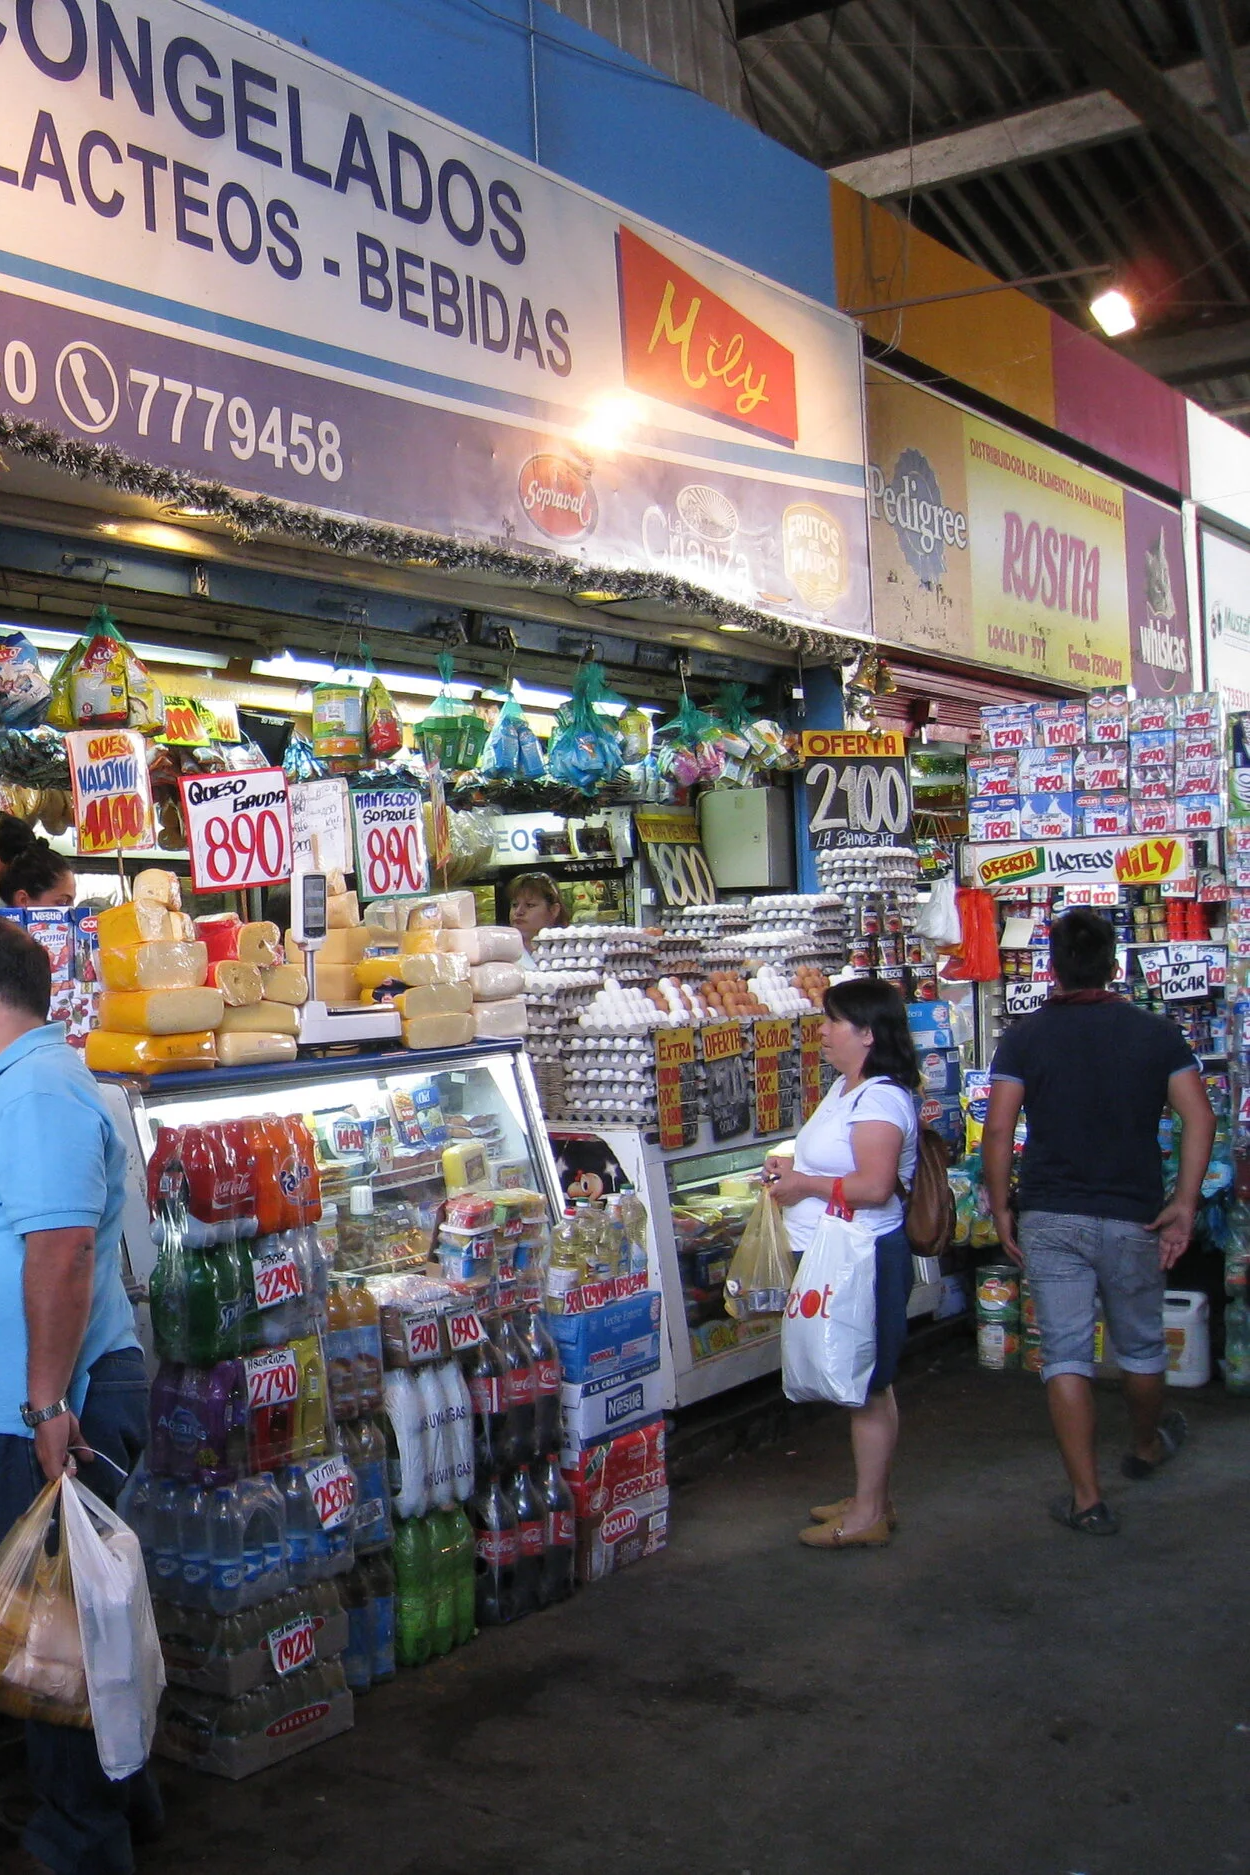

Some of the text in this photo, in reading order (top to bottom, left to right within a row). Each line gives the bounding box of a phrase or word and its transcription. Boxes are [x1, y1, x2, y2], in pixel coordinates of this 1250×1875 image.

[356, 231, 573, 378] BEBIDAS
[648, 280, 770, 414] Mily
[129, 367, 344, 482] 7779458
[523, 480, 591, 528] Sopraval
[867, 463, 968, 553] Pedigree
[787, 512, 841, 555] FRUTOS
[789, 548, 841, 584] MAIPO
[1003, 512, 1100, 622] ROSITA
[1139, 619, 1187, 674] whiskas
[188, 779, 247, 806] QUESO
[355, 790, 417, 809] MANTECOSO
[805, 762, 909, 834] 2100
[363, 808, 417, 825] SOPROLE
[203, 809, 285, 882] 890
[816, 831, 895, 849] LA BANDEJA
[367, 824, 423, 894] 890
[981, 850, 1036, 881] OFERTA
[1049, 848, 1114, 872] LACTEOS
[1161, 975, 1206, 994] TOCAR
[1171, 964, 1190, 977] NO
[1014, 984, 1032, 994] NO
[658, 1038, 691, 1062] EXTRA
[704, 1028, 743, 1058] OFERTA
[409, 1322, 438, 1354] 590
[451, 1312, 480, 1347] 890
[589, 1373, 626, 1394] LA CREMA
[613, 1470, 661, 1502] SOPROLE
[602, 1512, 636, 1538] COLUN
